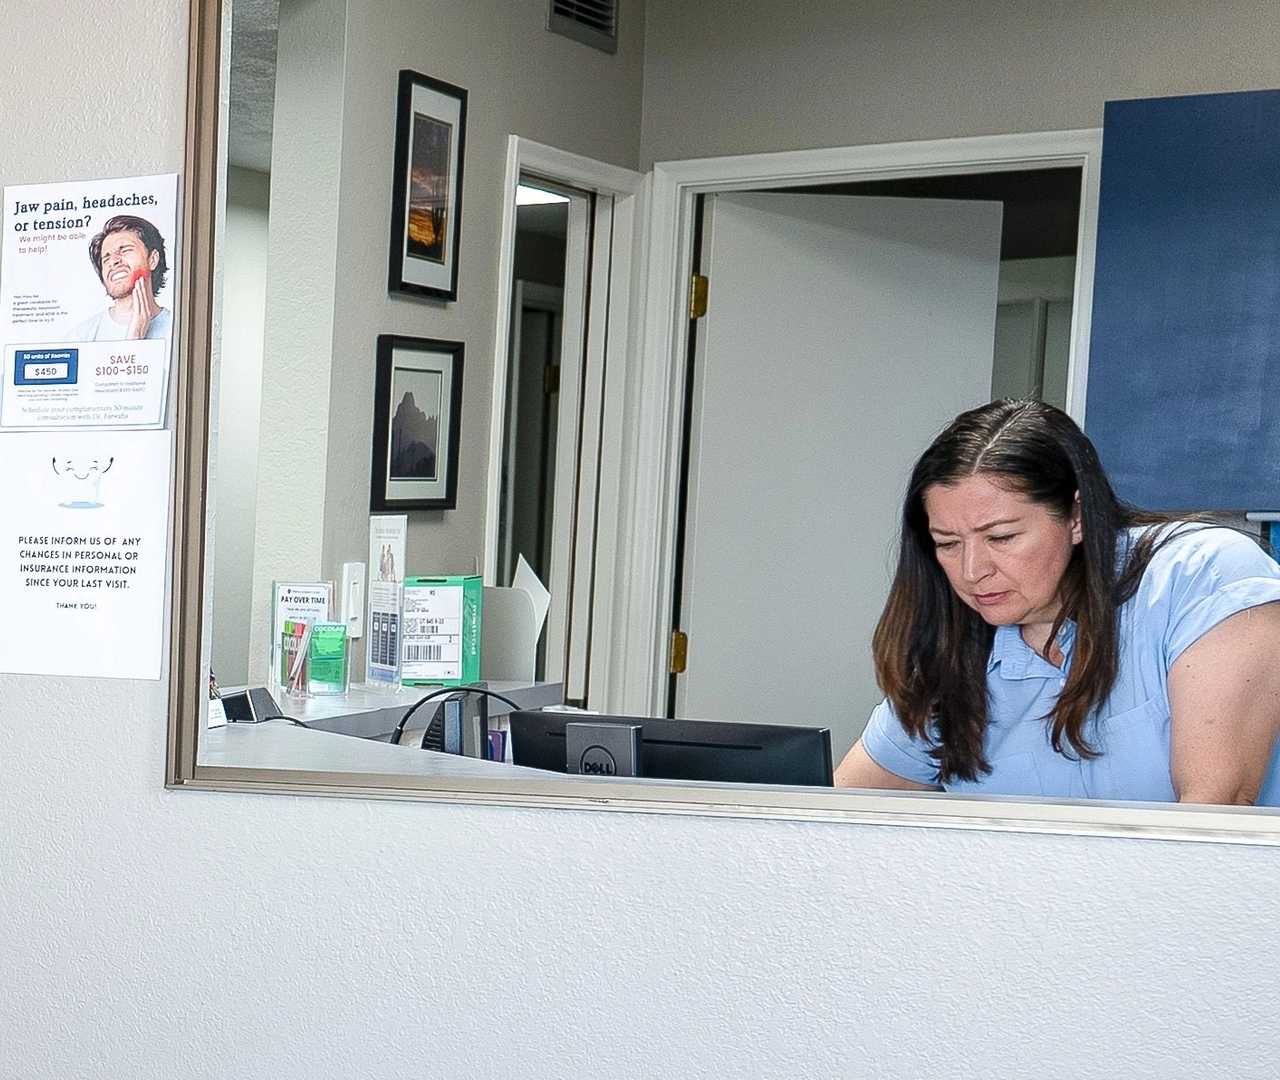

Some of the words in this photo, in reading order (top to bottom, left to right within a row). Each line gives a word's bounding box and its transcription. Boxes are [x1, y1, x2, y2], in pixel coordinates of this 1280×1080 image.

[14, 201, 40, 215] Jaw
[44, 199, 78, 214] pain,
[82, 193, 158, 209] headaches,
[14, 222, 29, 232] or
[33, 215, 92, 231] tension?
[19, 235, 31, 243] We
[33, 234, 55, 243] might
[69, 232, 87, 240] able
[28, 245, 48, 255] help!
[110, 355, 136, 364] SAVE
[35, 368, 57, 376] $450
[18, 536, 49, 545] PLEASE
[51, 536, 87, 546] INFORM
[89, 537, 101, 546] US
[104, 537, 117, 546] OF
[122, 537, 141, 546] ANY
[19, 550, 60, 559] CHANGES
[62, 551, 72, 559] IN
[74, 551, 122, 560] PERSONAL
[124, 552, 139, 560] OR
[20, 564, 69, 573] INSURANCE
[72, 565, 136, 574] INFORMATION
[25, 578, 50, 587] SINCE
[53, 578, 79, 588] YOUR
[81, 579, 102, 588] LAST
[105, 580, 130, 589] VISIT.
[281, 596, 293, 604] PAY
[584, 762, 612, 774] DELL
